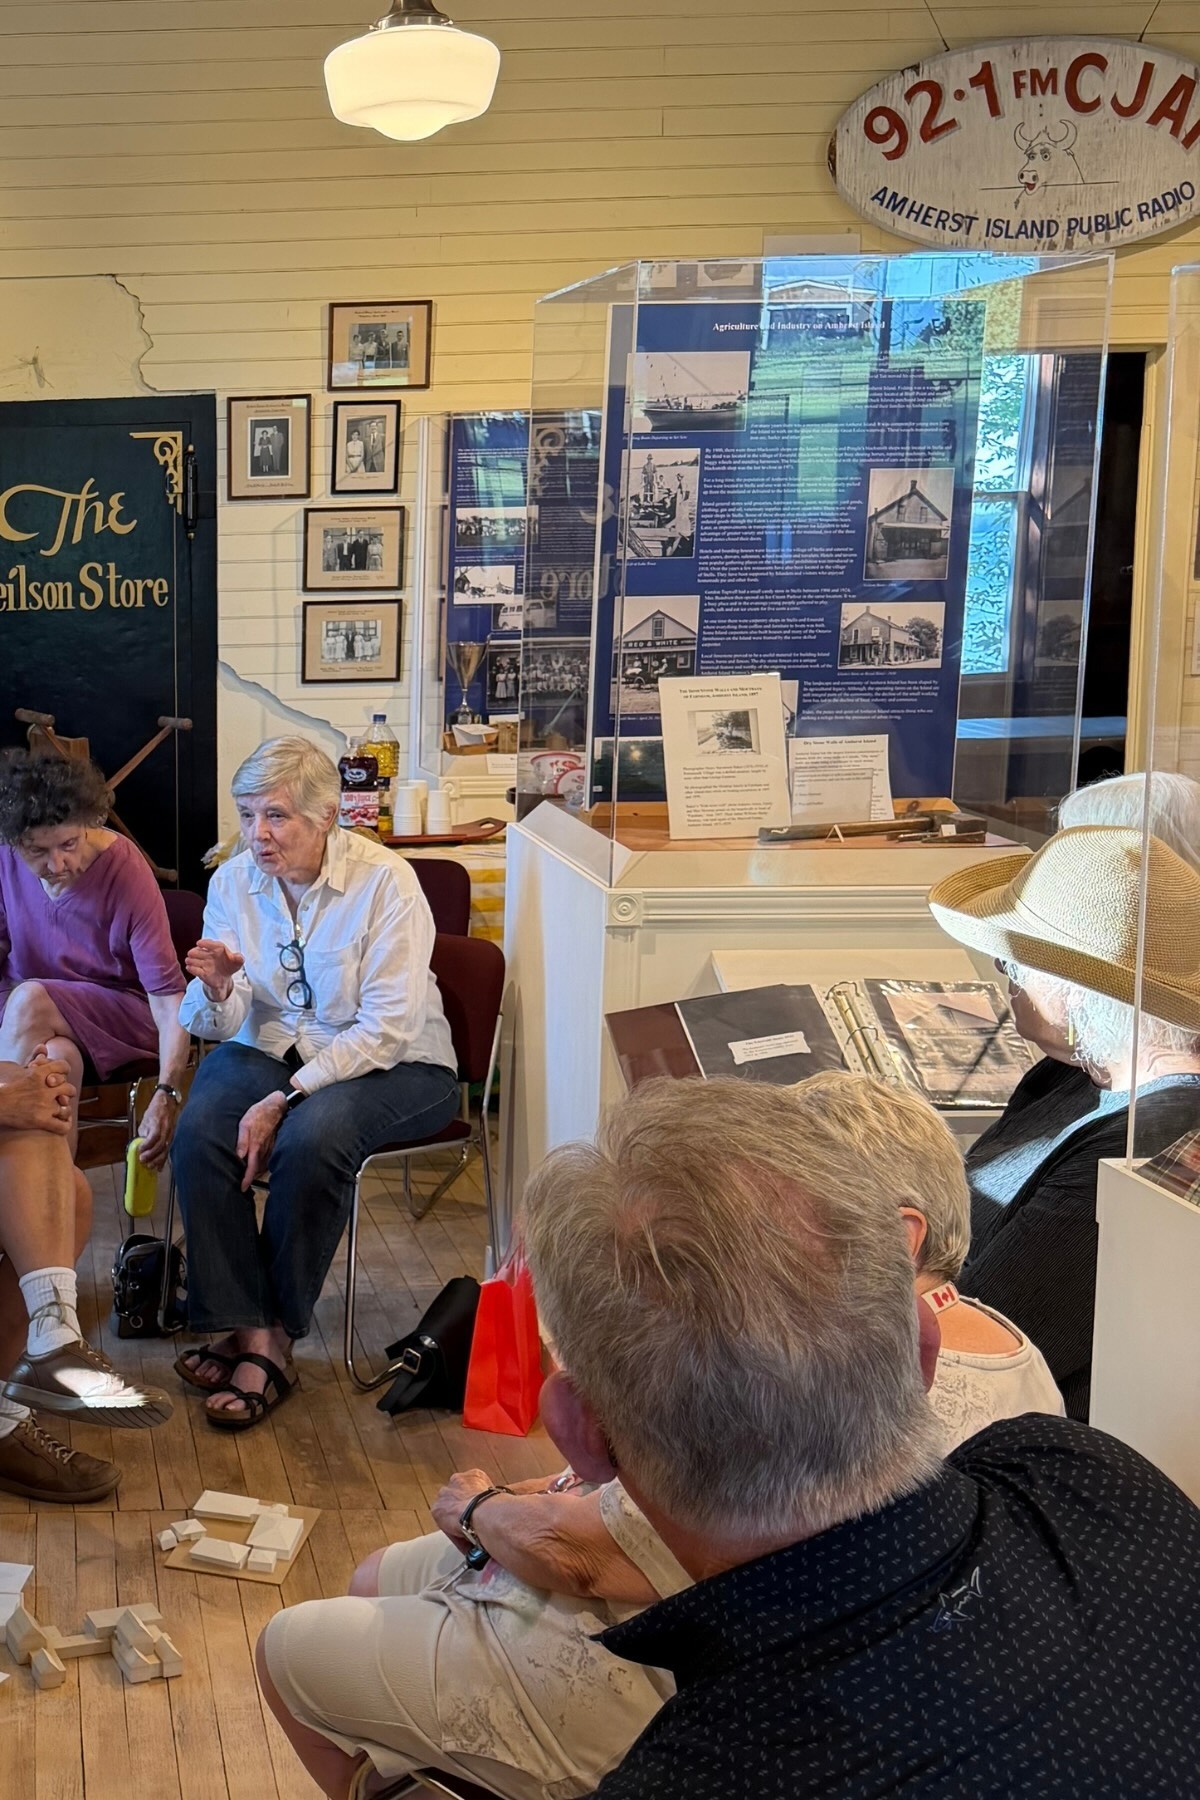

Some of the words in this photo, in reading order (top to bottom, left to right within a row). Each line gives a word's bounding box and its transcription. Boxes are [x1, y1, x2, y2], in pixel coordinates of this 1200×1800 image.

[1013, 67, 1058, 98] FM
[870, 186, 979, 236] AMHERST
[985, 218, 1059, 240] ISLAND
[1067, 207, 1132, 236] PUBLIC
[1137, 180, 1196, 223] RADIO
[713, 322, 758, 332] Agriculture
[778, 322, 810, 331] Industry
[79, 562, 168, 610] Store
